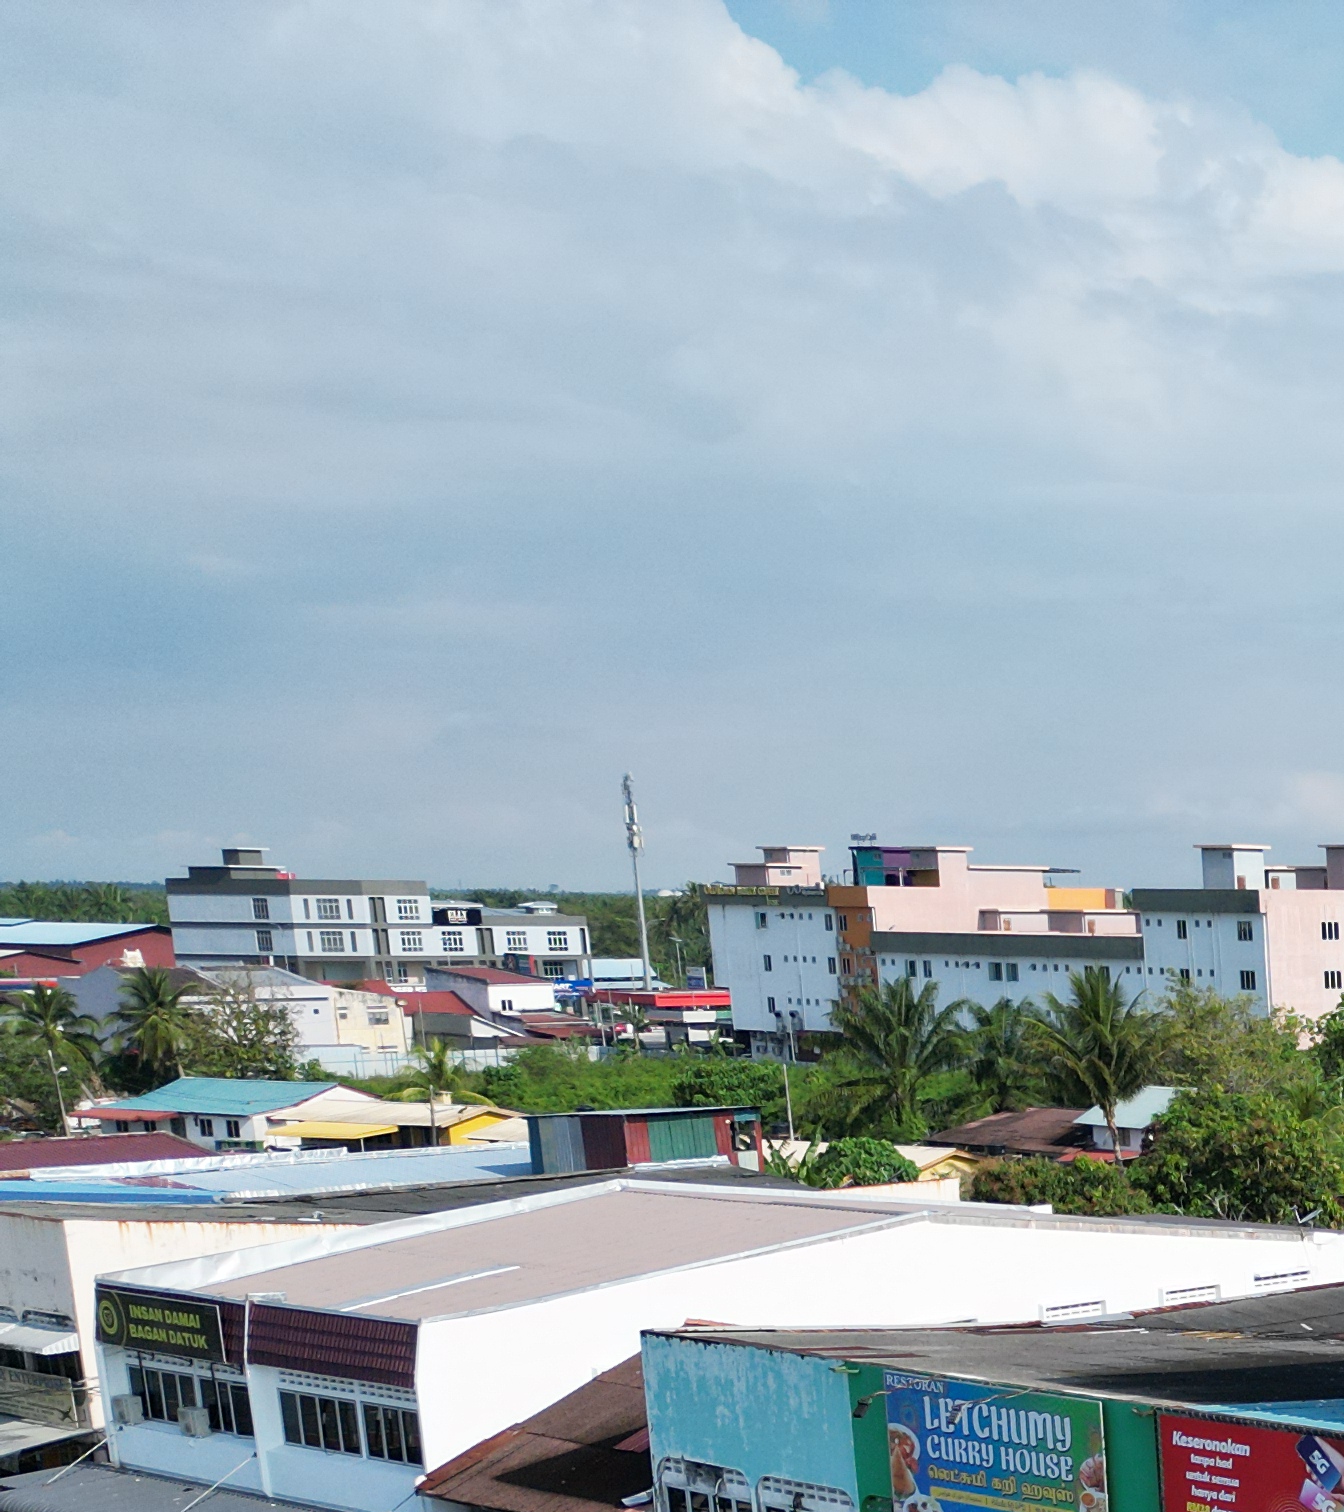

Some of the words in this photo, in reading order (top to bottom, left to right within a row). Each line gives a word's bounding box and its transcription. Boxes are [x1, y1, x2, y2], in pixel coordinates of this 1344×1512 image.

[129, 1304, 162, 1322] INSAN
[164, 1310, 200, 1329] DAMAI
[128, 1323, 167, 1342] BAGAN
[169, 1331, 208, 1350] DATUK
[886, 1375, 944, 1393] RESTORAN
[923, 1396, 1072, 1452] LETCHUMY
[1172, 1430, 1250, 1457] Keseronokan
[926, 1435, 994, 1468] CURRY
[1000, 1447, 1074, 1482] HOUSE
[1308, 1450, 1331, 1475] 5G
